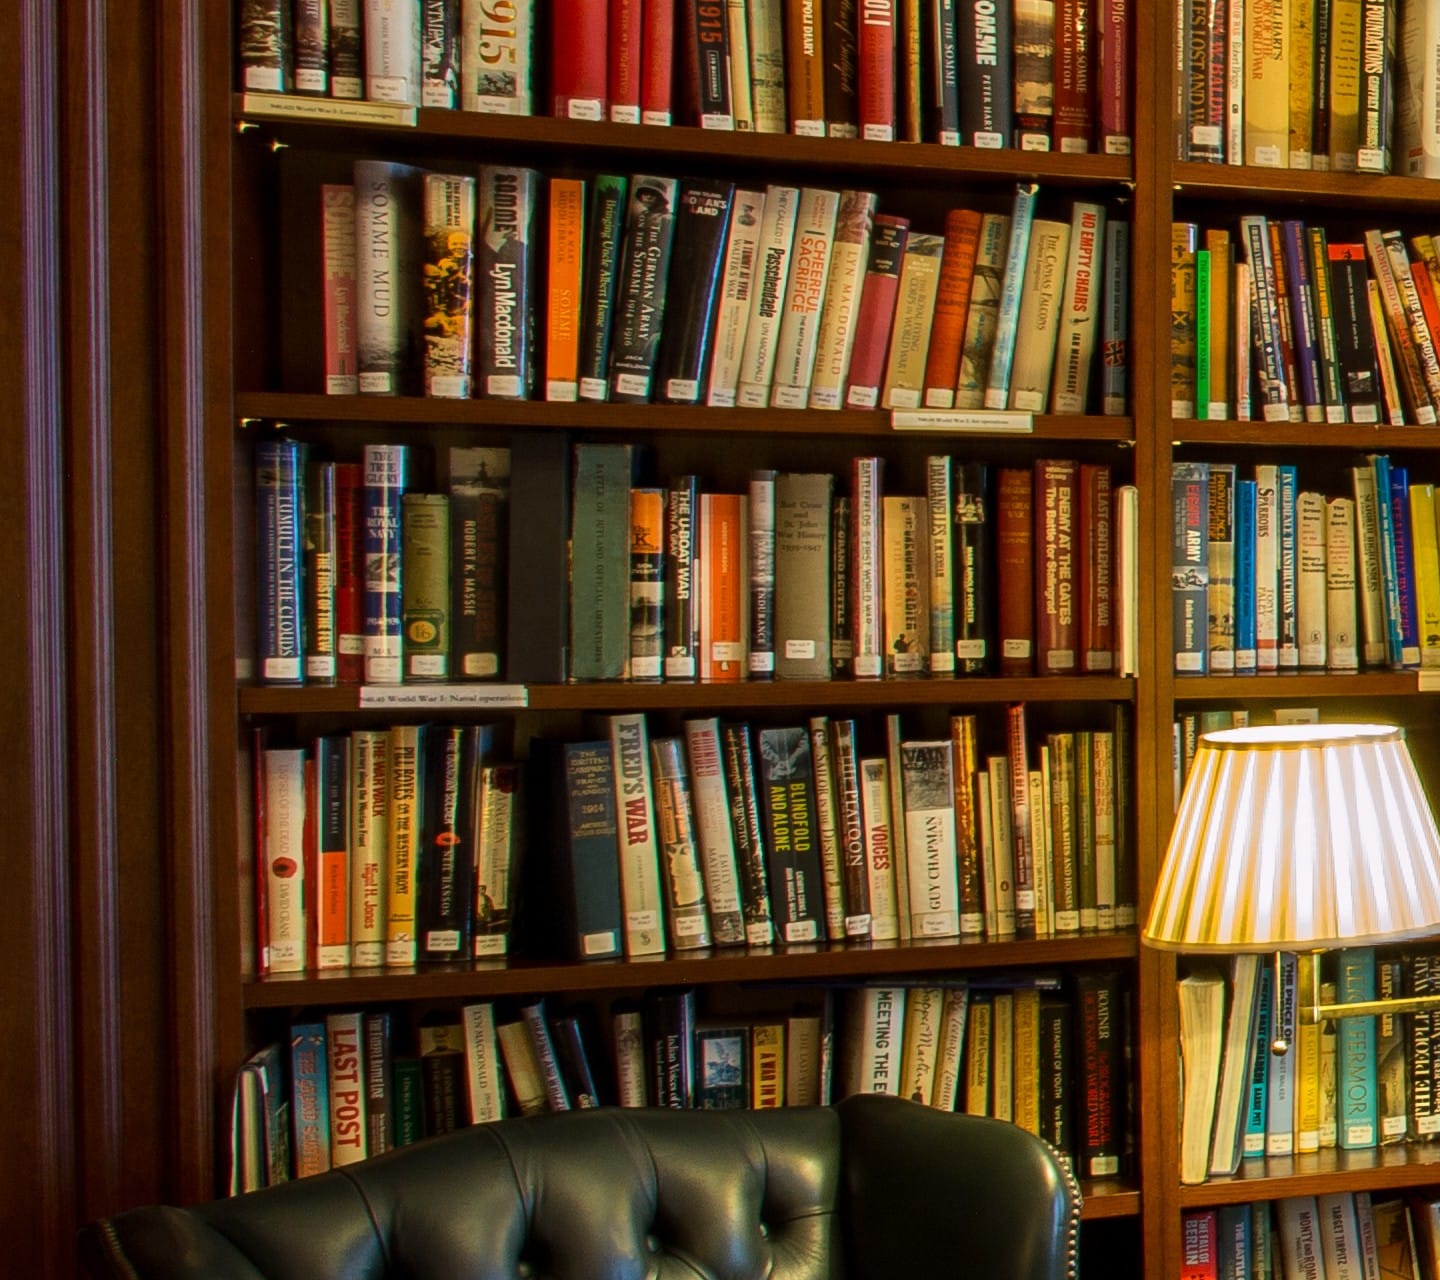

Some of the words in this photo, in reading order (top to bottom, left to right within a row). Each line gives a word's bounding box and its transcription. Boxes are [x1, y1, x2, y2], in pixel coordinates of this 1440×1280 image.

[369, 180, 388, 260] SOMME
[1081, 213, 1095, 231] NO
[791, 237, 812, 312] SACRIFICE
[1077, 234, 1094, 268] EMPTY
[373, 270, 390, 318] MUD
[494, 263, 516, 288] Lyn
[759, 247, 786, 318] Passchendaele
[805, 239, 827, 313] CHEERFUL
[1074, 271, 1091, 312] CHAIRS
[494, 290, 516, 368] Macdonald
[1058, 487, 1072, 529] ENEMY
[1257, 487, 1274, 537] SPARROWS
[1186, 530, 1201, 562] ARMY
[1059, 580, 1072, 625] GATES
[617, 722, 642, 792] FRED'S
[625, 797, 648, 846] WAR
[770, 786, 788, 814] AND
[789, 783, 810, 852] BLINDFOLD
[773, 817, 791, 852] ALONE
[871, 825, 890, 870] VOICES
[927, 816, 941, 876] CHAPMAN
[930, 878, 942, 910] GUY
[873, 991, 893, 1051] MEETING
[330, 1027, 360, 1084] LAST
[334, 1091, 360, 1148] POST
[1185, 1219, 1198, 1266] BERLIN
